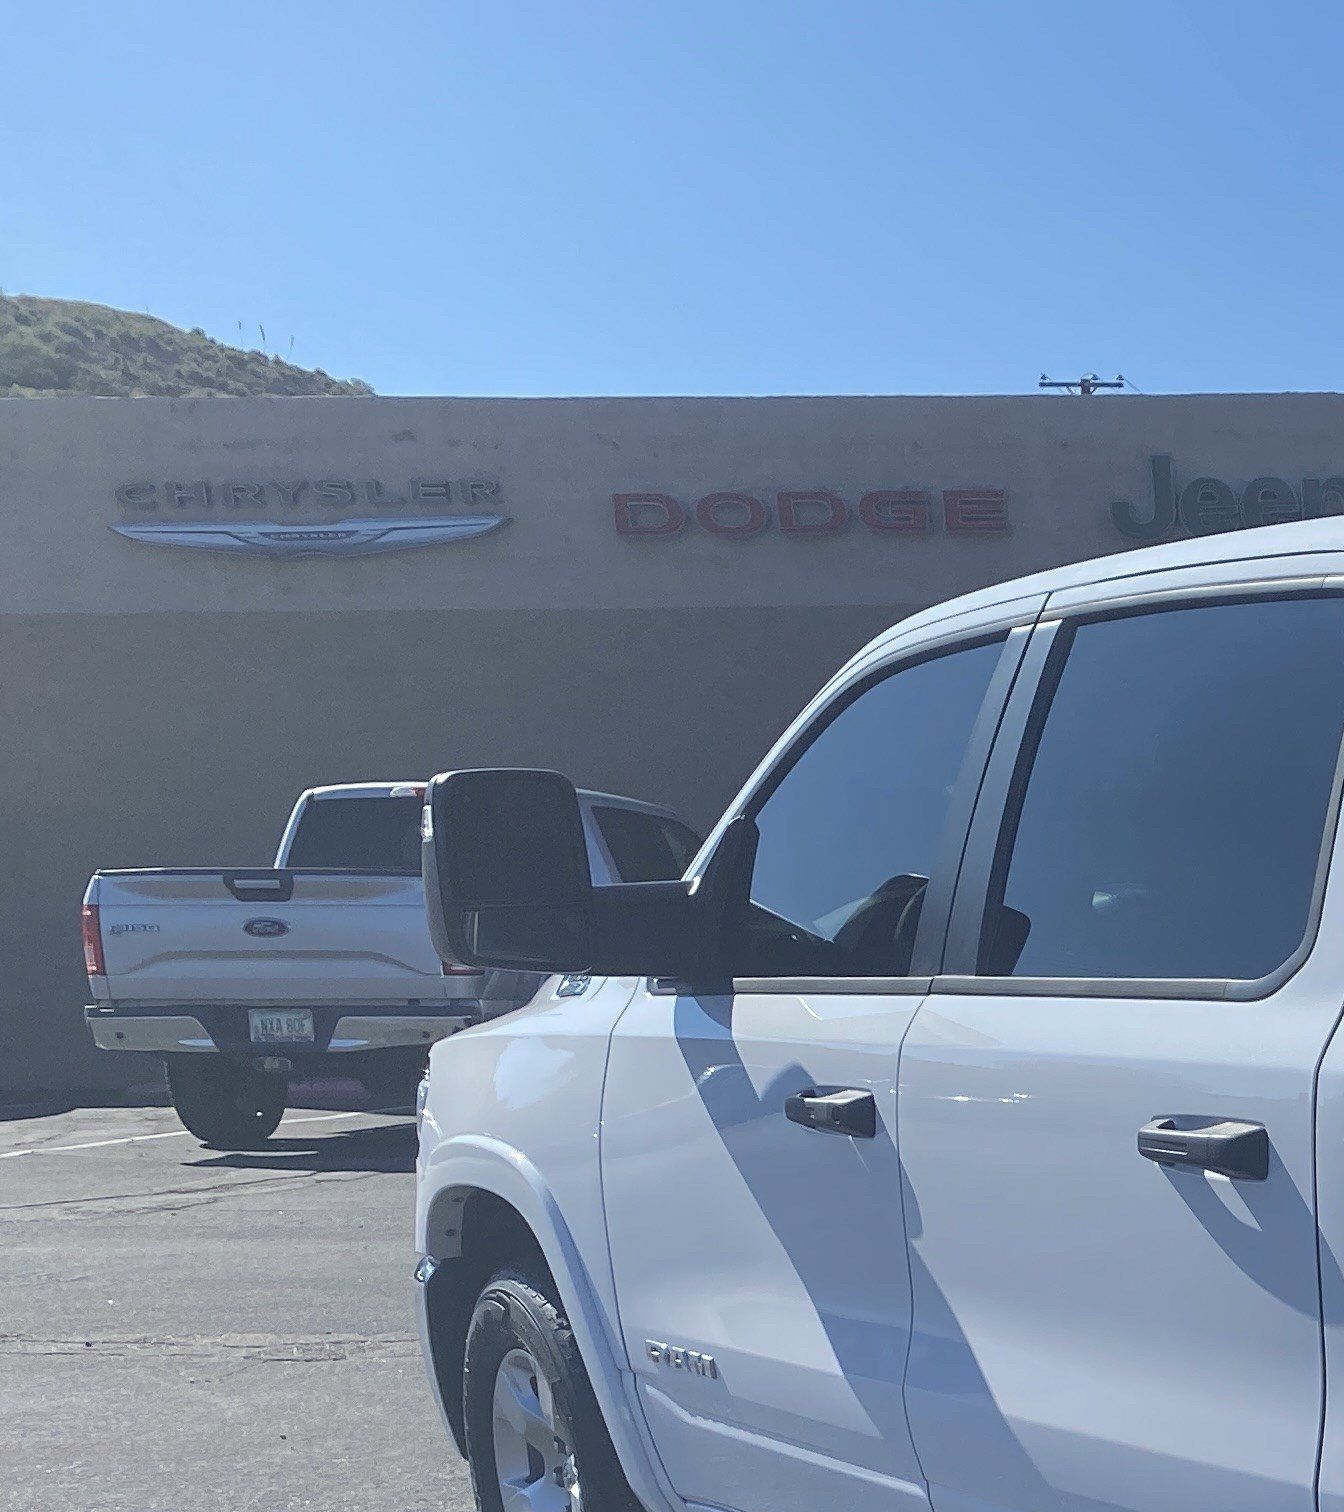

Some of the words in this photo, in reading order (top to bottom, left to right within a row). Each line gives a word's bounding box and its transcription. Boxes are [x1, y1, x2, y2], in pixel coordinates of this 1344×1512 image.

[114, 477, 502, 511] CHRYSLER
[611, 488, 1008, 537] DODGE
[645, 1339, 719, 1380] RAM
